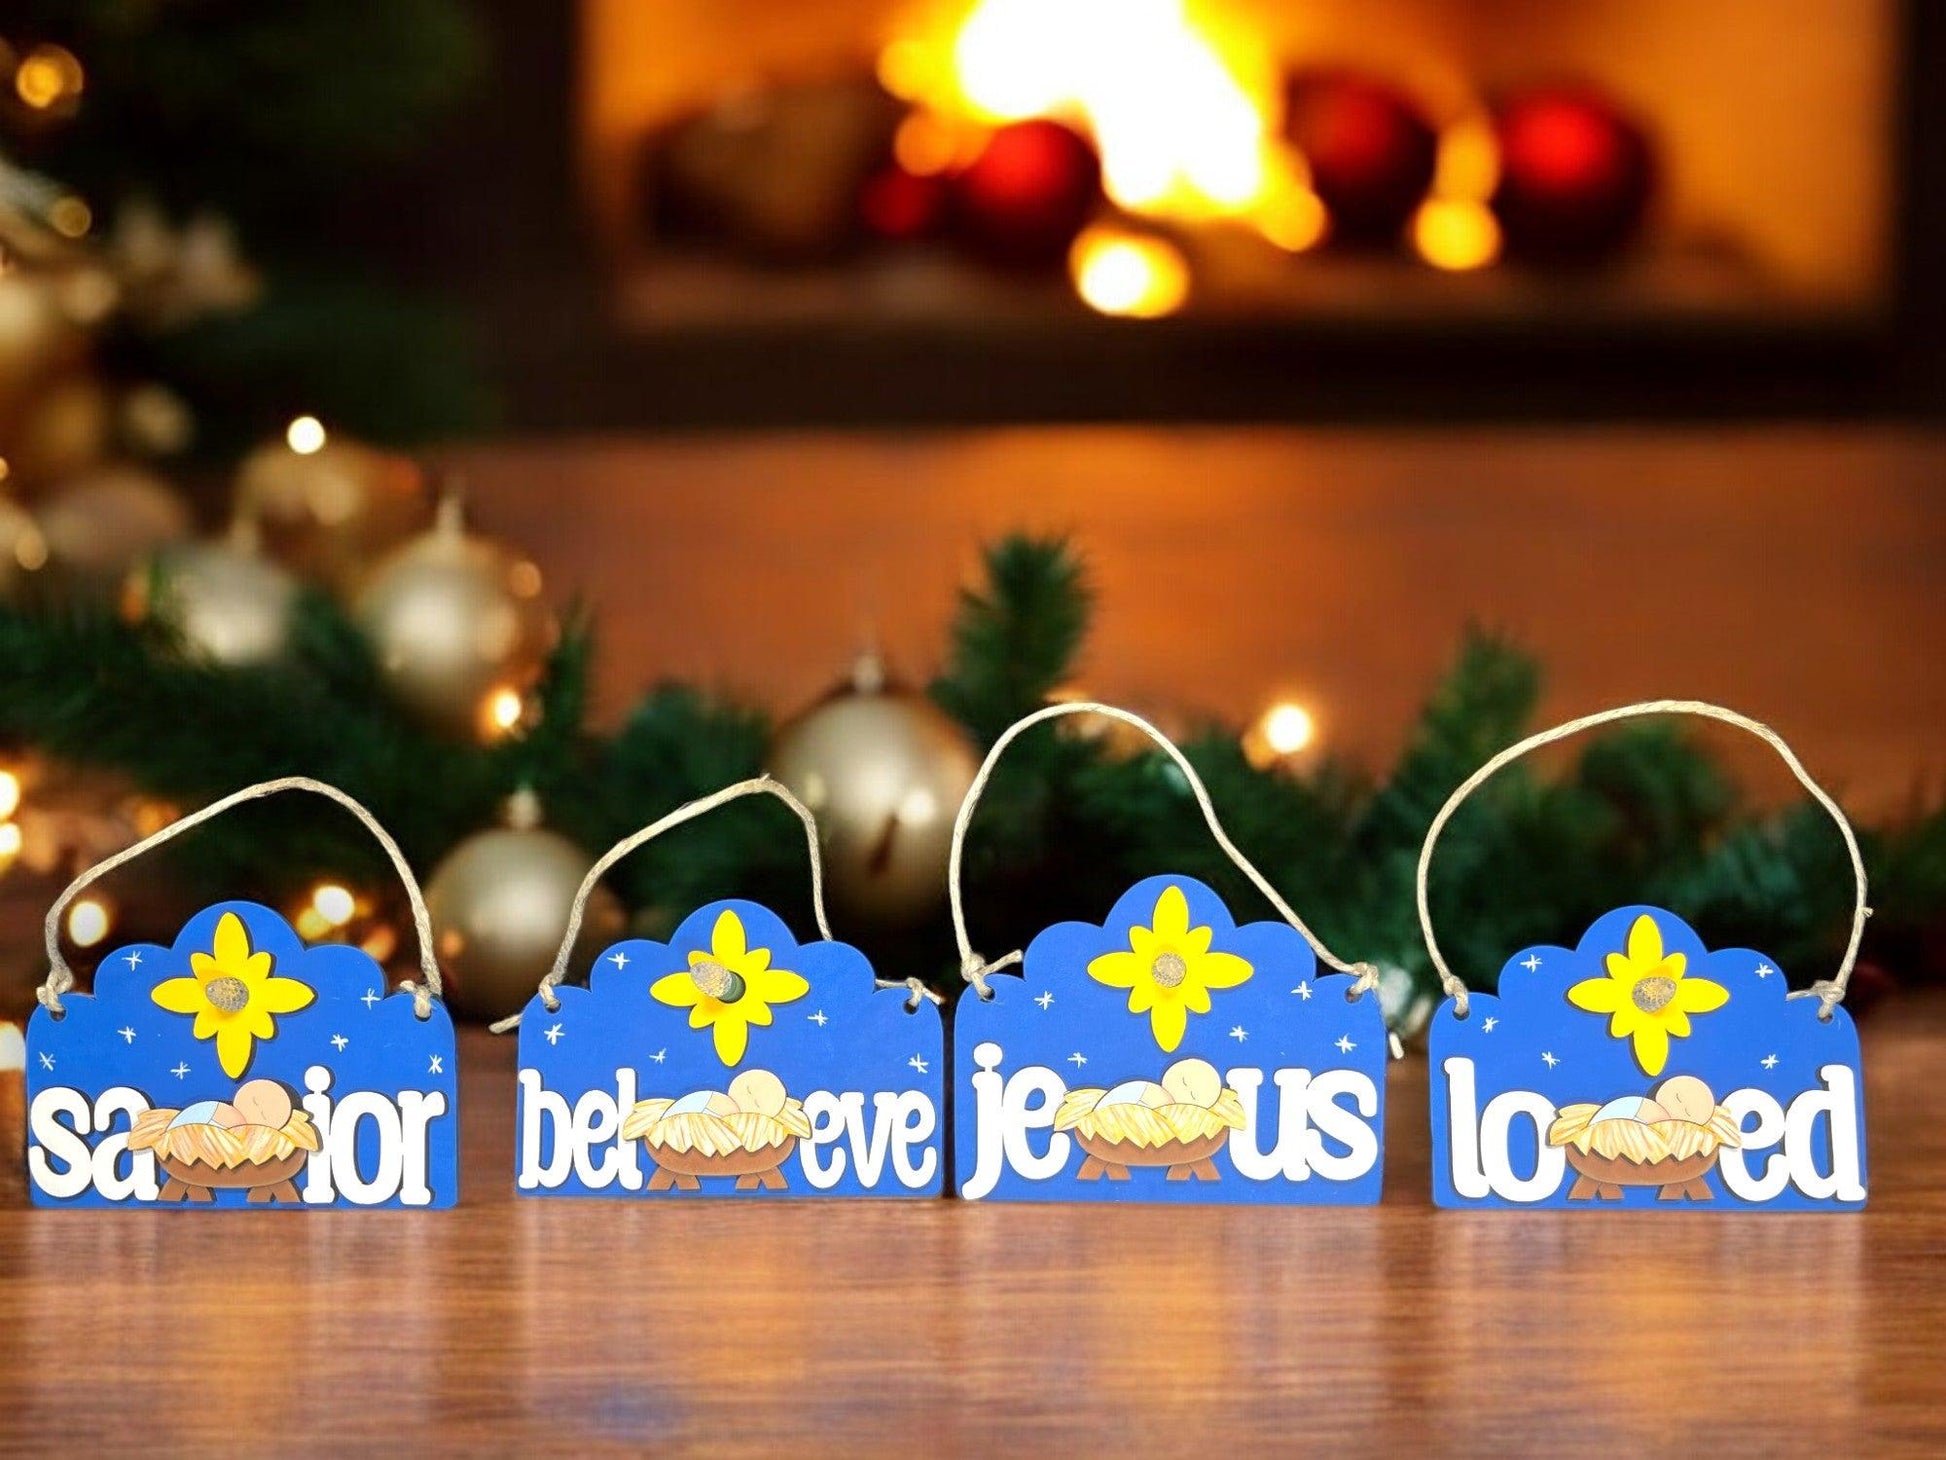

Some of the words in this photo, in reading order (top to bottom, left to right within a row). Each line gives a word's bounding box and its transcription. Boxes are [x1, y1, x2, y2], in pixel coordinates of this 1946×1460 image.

[29, 1065, 446, 1205] saior
[518, 1067, 937, 1189] beleve
[961, 1042, 1378, 1200] jeus
[1443, 1057, 1866, 1201] loed
